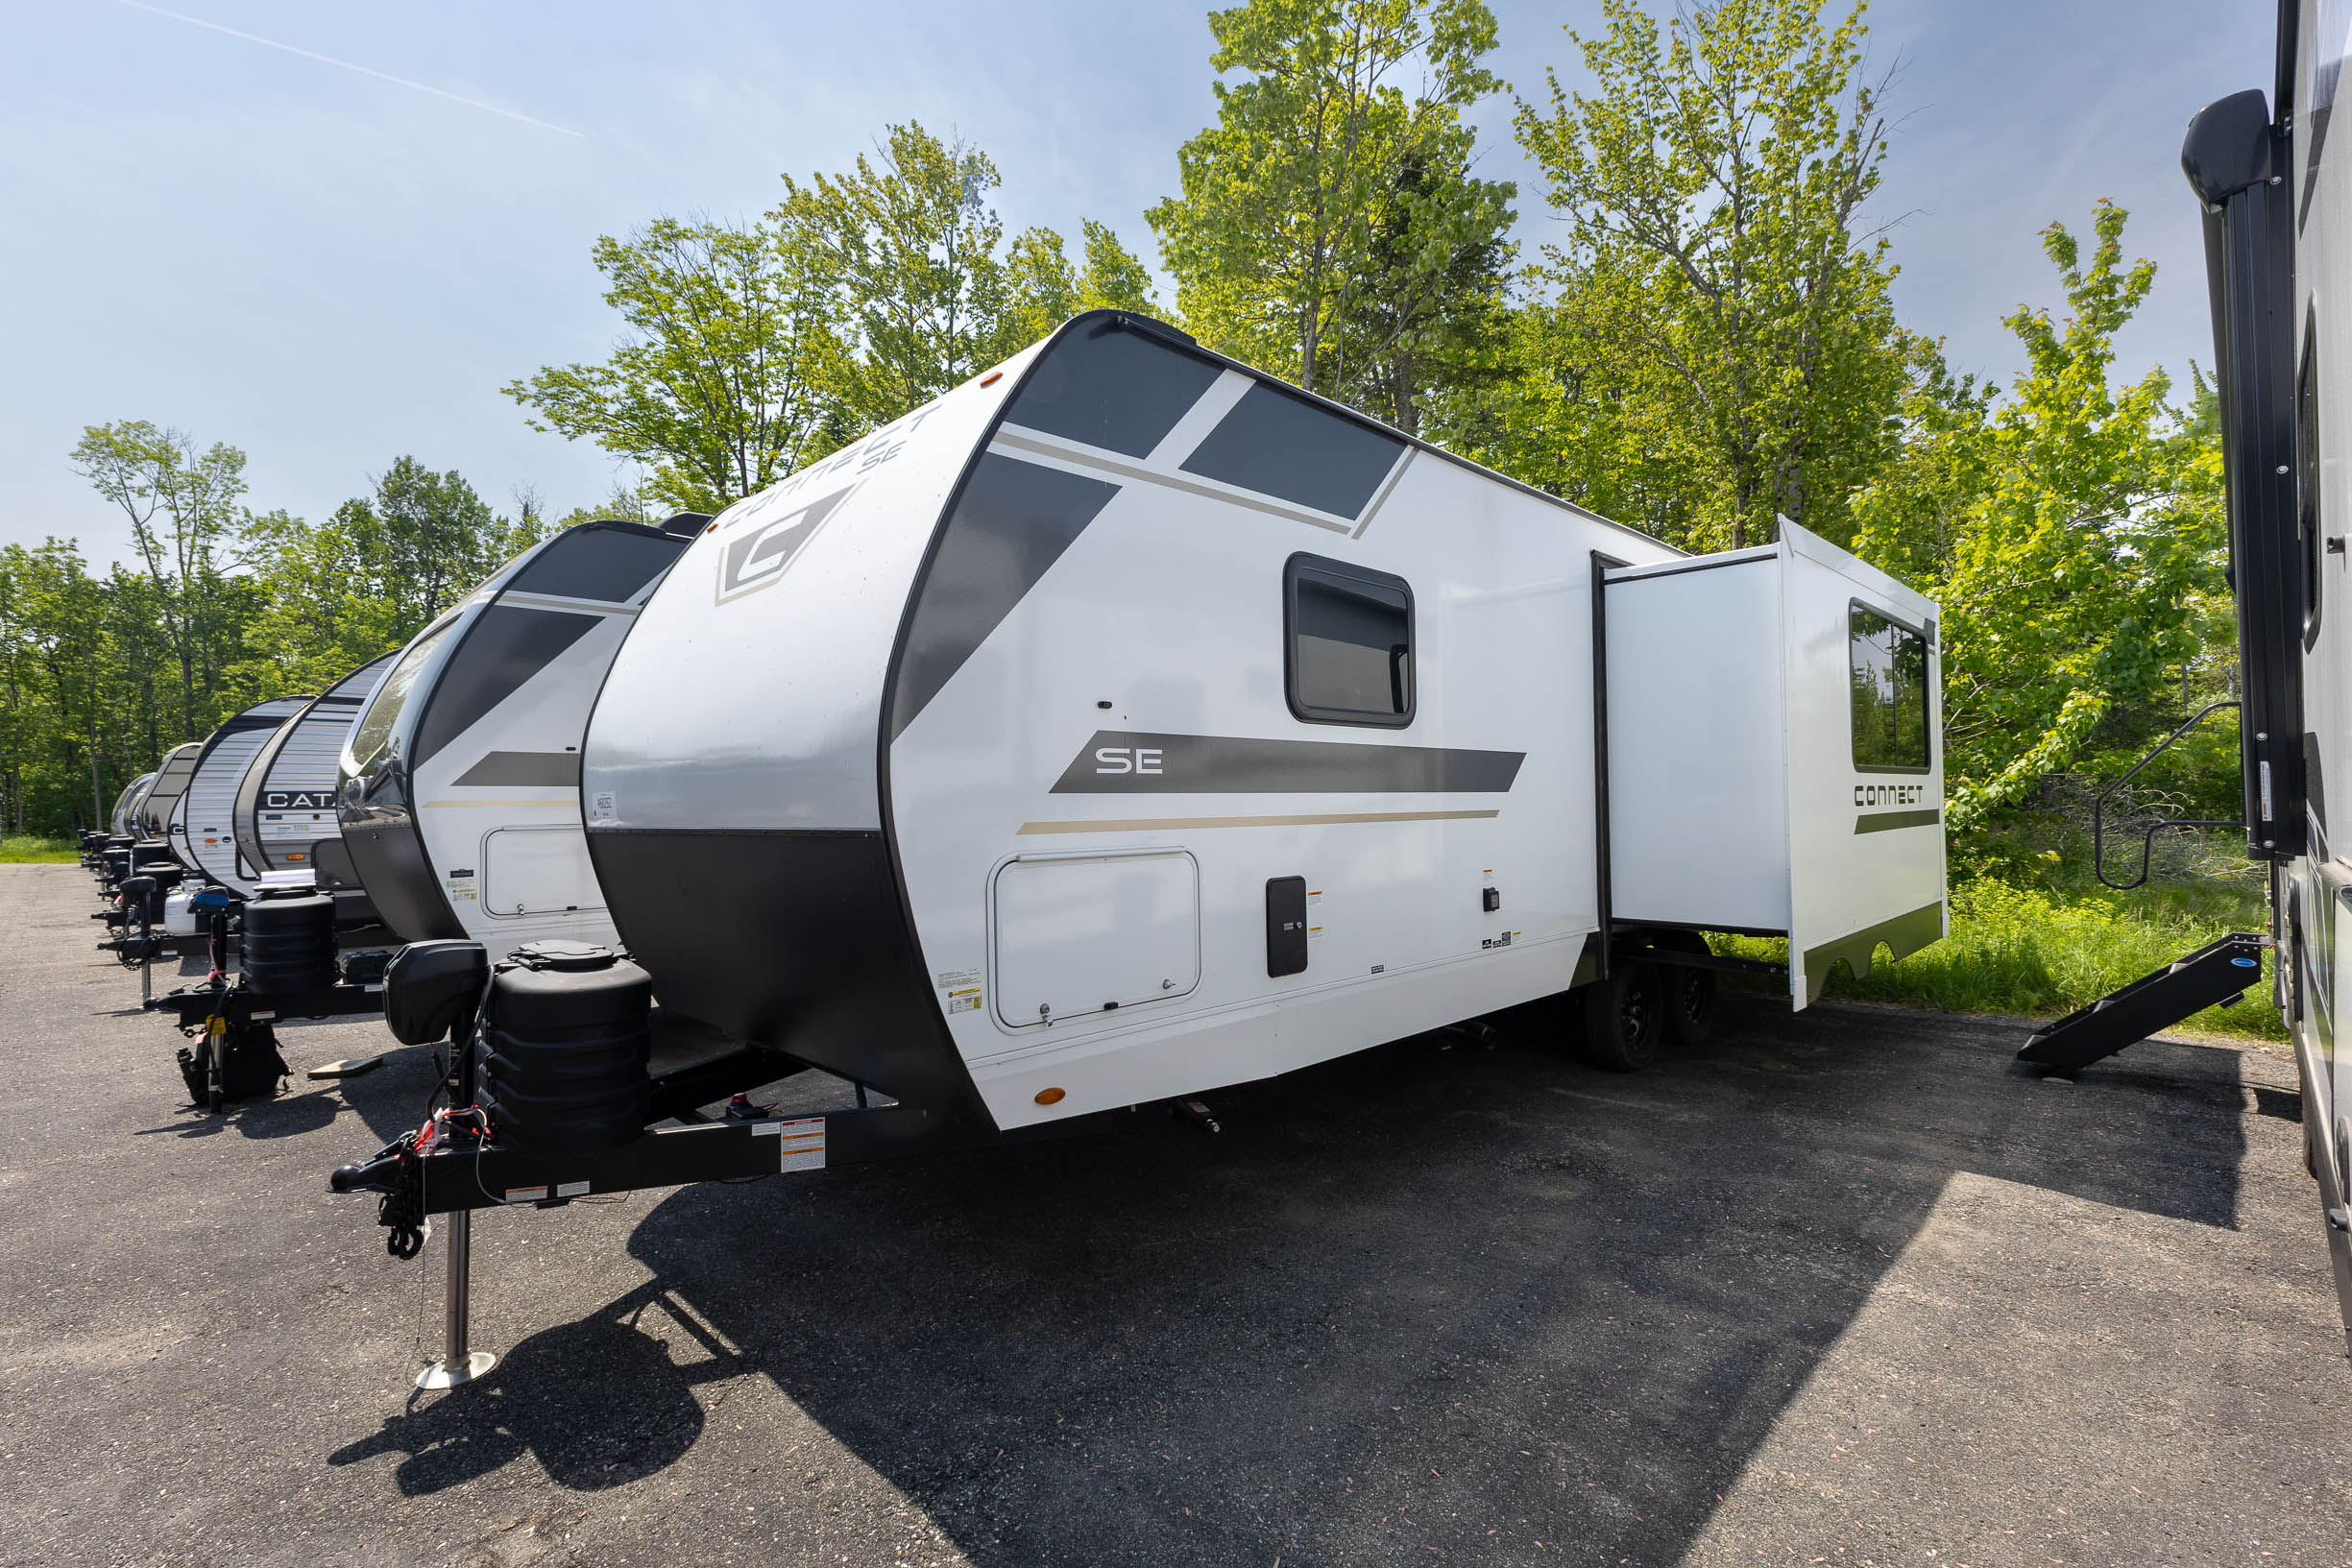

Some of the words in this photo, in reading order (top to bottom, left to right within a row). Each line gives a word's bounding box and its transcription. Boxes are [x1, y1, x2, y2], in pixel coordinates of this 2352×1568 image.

[856, 440, 908, 475] SE
[1095, 747, 1163, 775] SE
[1855, 785, 1924, 807] CONNECT
